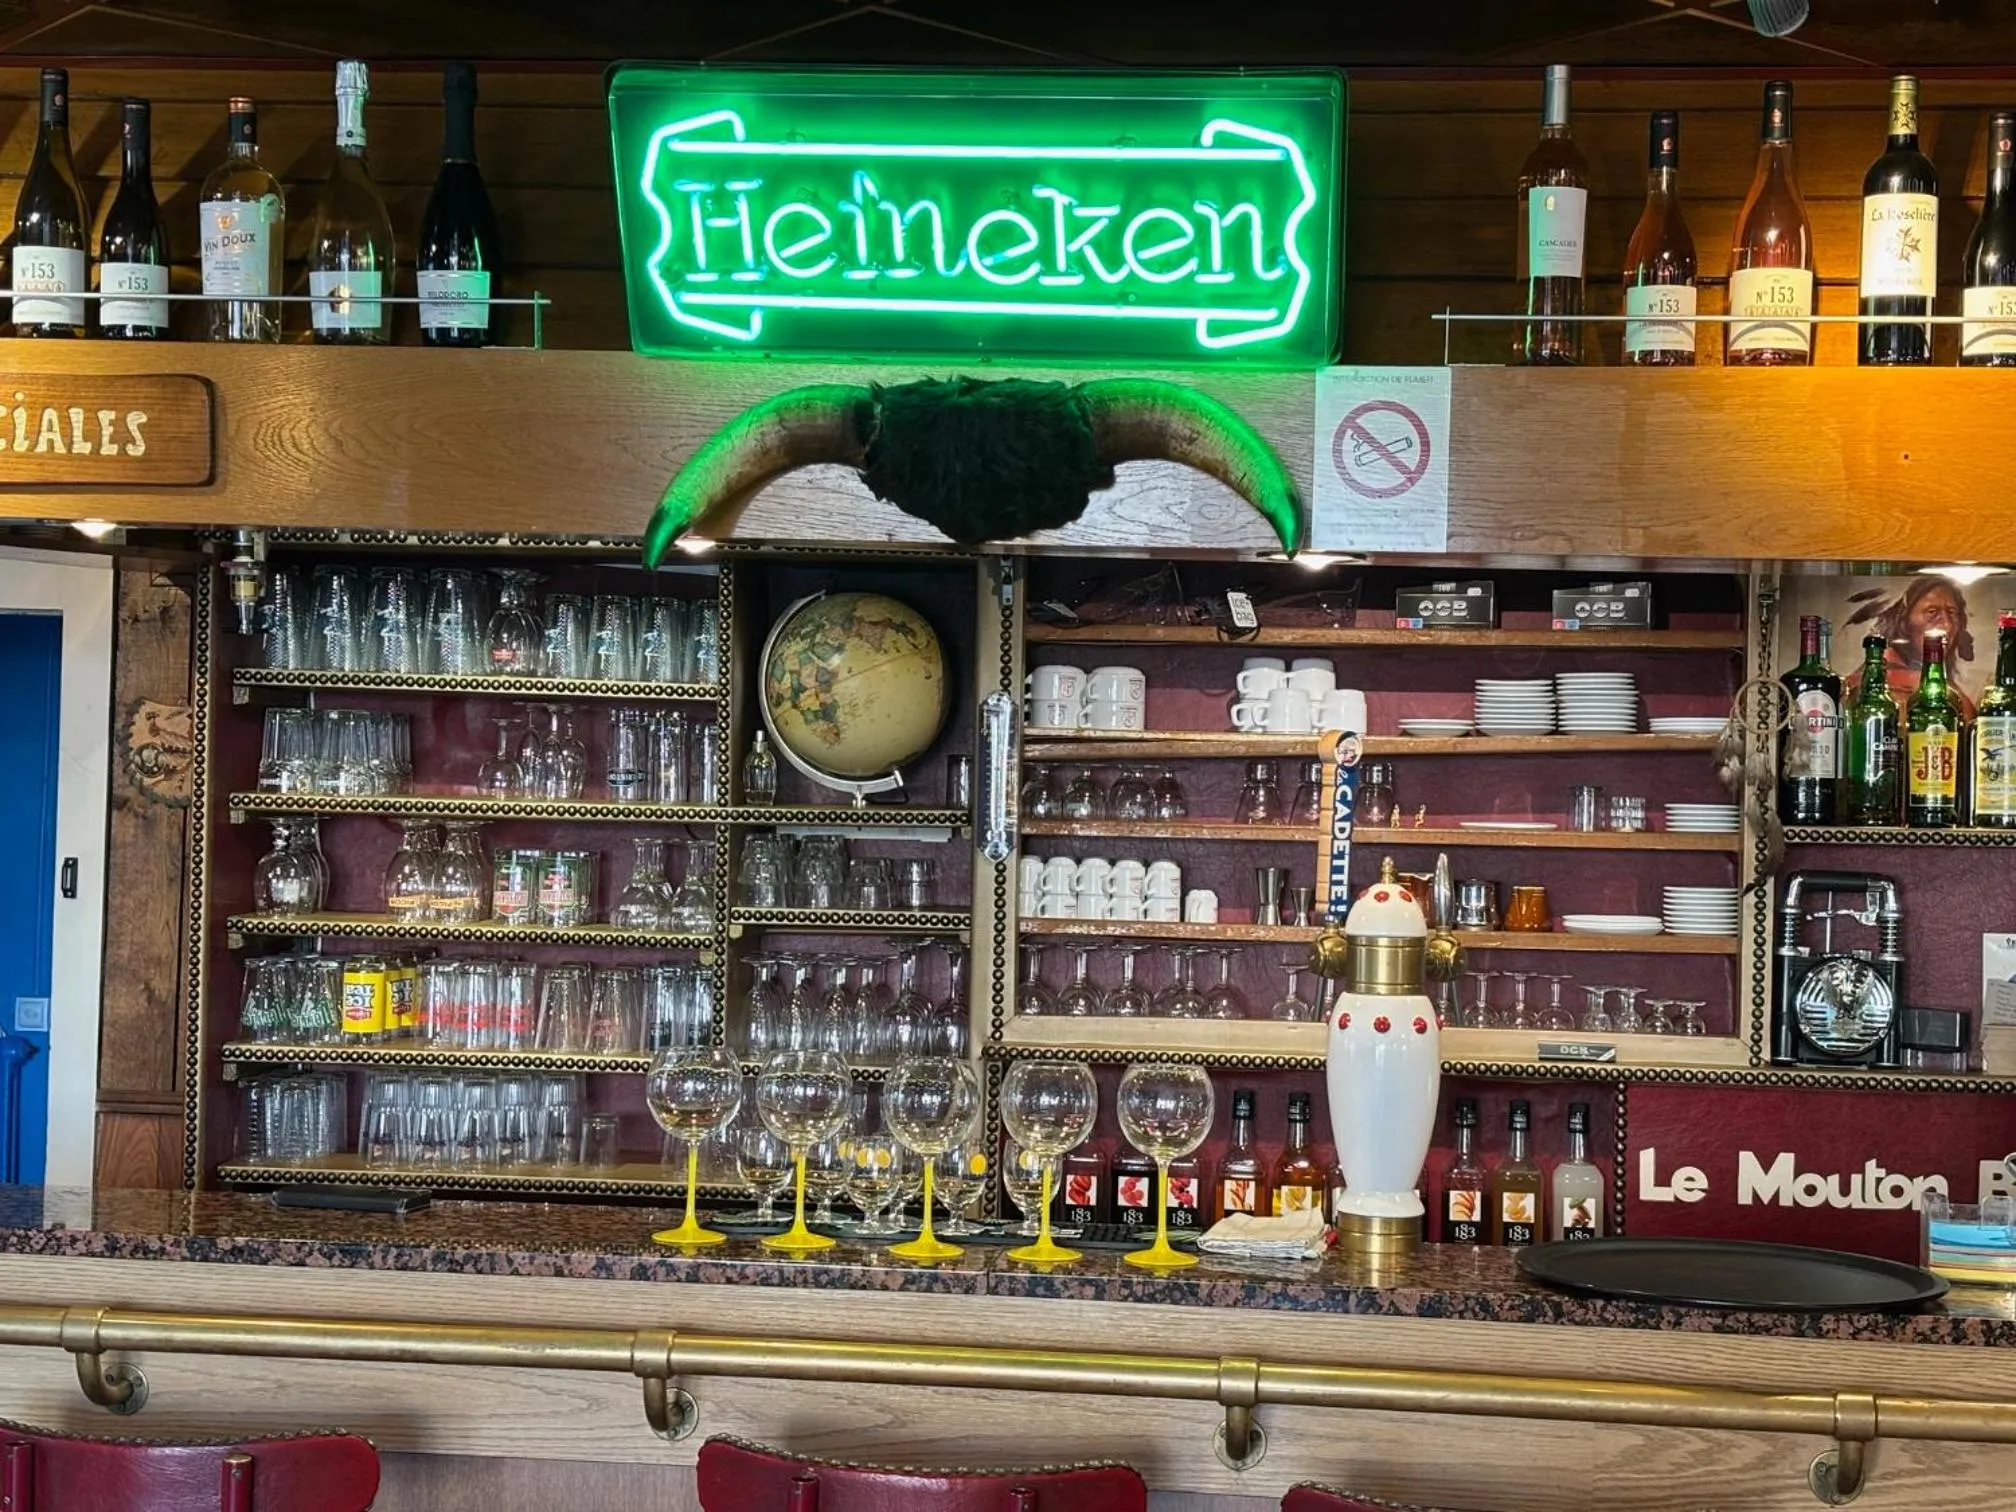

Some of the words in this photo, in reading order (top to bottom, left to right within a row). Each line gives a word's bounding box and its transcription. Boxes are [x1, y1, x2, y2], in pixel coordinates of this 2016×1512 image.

[673, 170, 1289, 286] Heineken
[221, 232, 256, 248] DOUX
[1418, 600, 1469, 617] OCB
[1574, 601, 1626, 618] OCB
[1638, 1147, 1709, 1203] Le
[1737, 1149, 1949, 1211] Mouton
